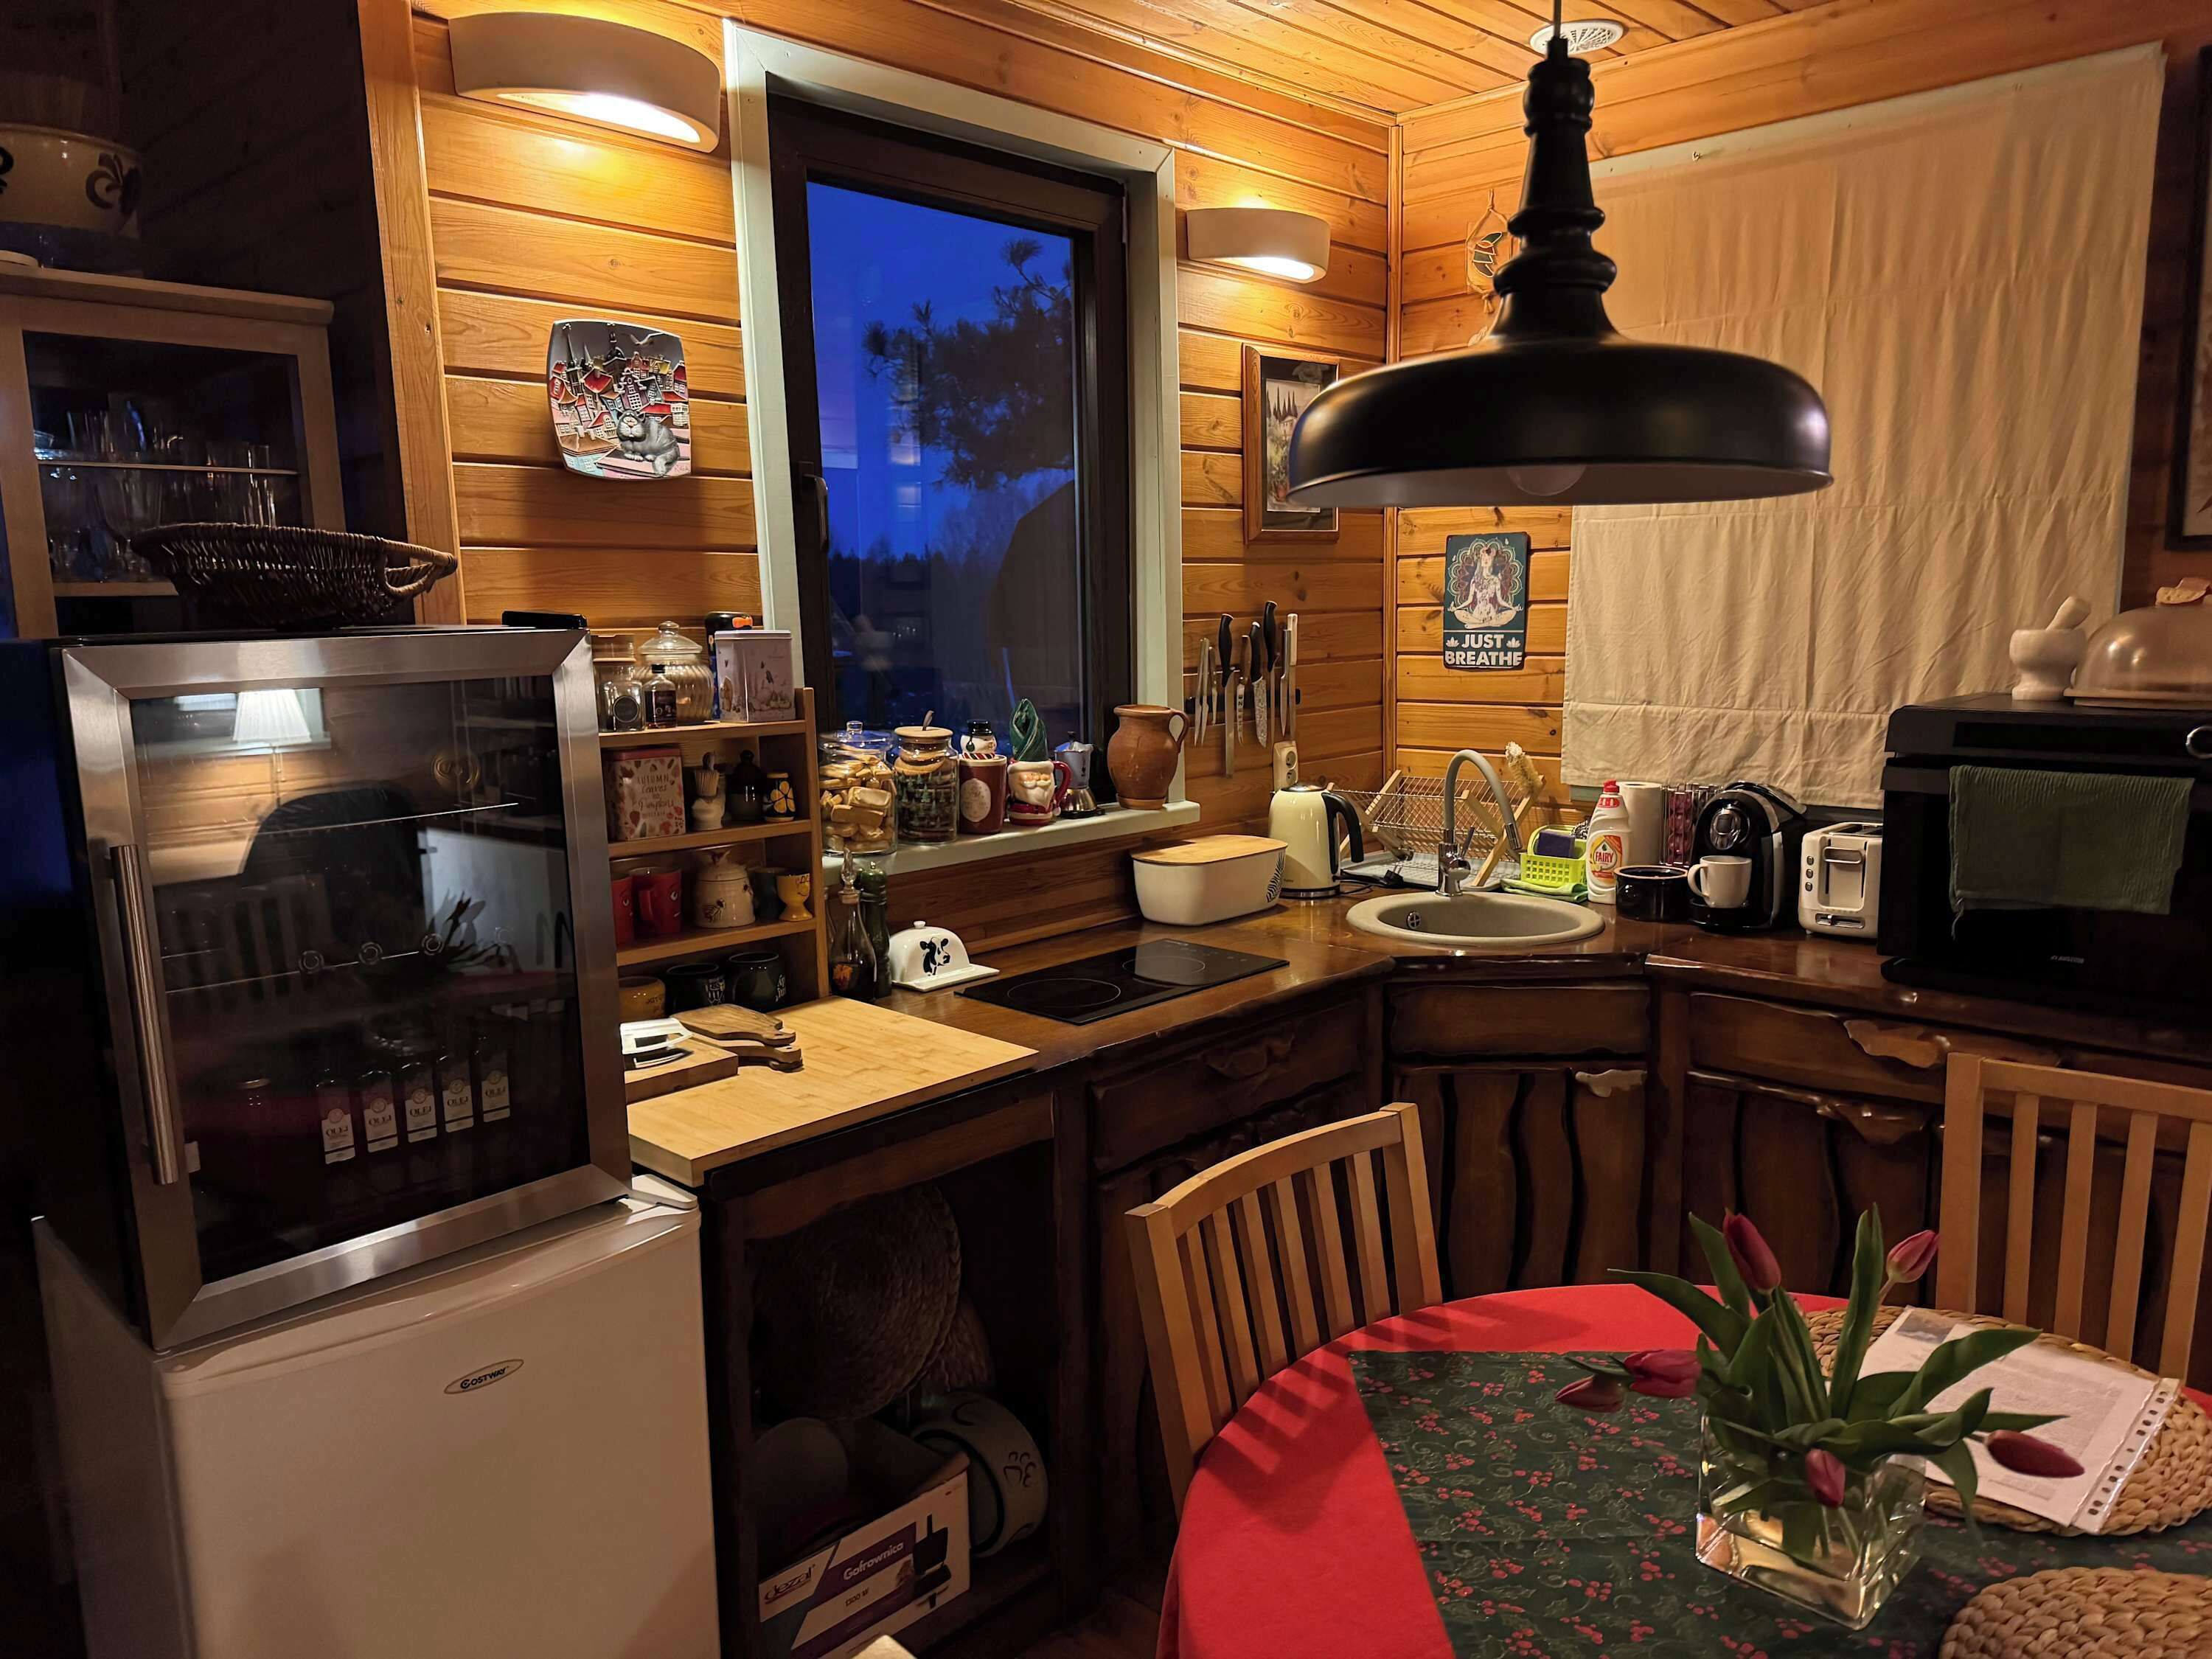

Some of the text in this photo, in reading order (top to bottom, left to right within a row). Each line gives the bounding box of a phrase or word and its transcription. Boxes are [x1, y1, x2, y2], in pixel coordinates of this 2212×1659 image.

[1461, 634, 1505, 649] JUST
[1444, 650, 1523, 666] BREATHE
[1595, 852, 1614, 863] FAIRY
[460, 1367, 507, 1389] COSTWAY
[842, 1541, 905, 1582] Gofrownica
[764, 1568, 813, 1601] dezal
